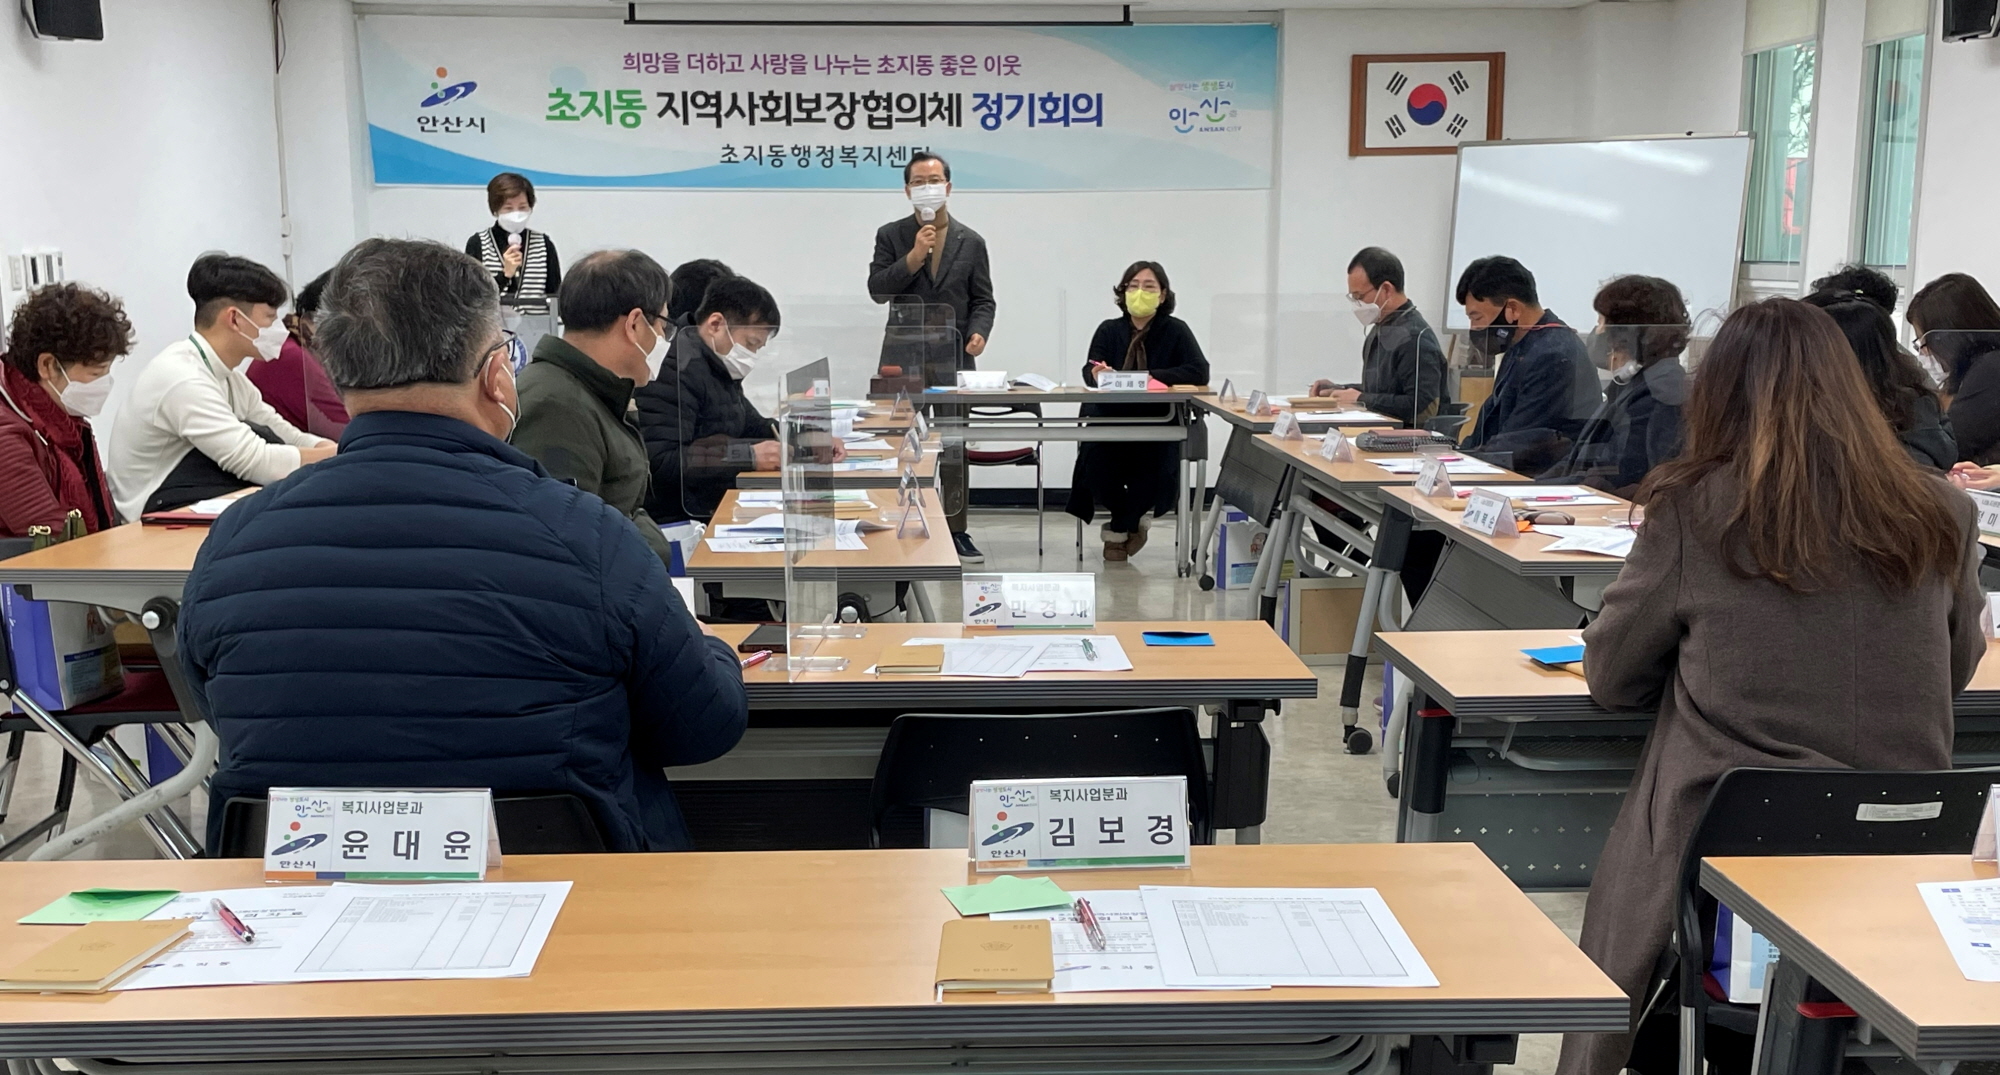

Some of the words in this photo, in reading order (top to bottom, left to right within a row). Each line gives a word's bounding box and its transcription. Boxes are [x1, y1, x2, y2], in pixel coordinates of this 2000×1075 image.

[622, 51, 681, 74] 희망을
[687, 52, 745, 75] 더하고
[750, 53, 808, 75] 사랑을
[814, 54, 872, 76] 나누는
[876, 55, 934, 76] 초지동
[939, 55, 978, 76] 좋은
[984, 55, 1022, 76] 이웃
[545, 87, 648, 129] 초지동
[656, 89, 963, 130] 지역사회보장협의체
[971, 91, 1103, 131] 정기회의
[416, 115, 486, 134] 안산시
[1049, 788, 1128, 802] 복지사업분과
[341, 800, 424, 815] 복지사업분과
[1049, 817, 1075, 847] 김
[1098, 816, 1125, 844] 보
[1147, 815, 1174, 845] 경
[341, 830, 369, 860] 윤
[393, 830, 420, 860] 대
[443, 830, 471, 860] 윤
[990, 849, 1026, 859] 안산시
[279, 860, 316, 869] 안산시
